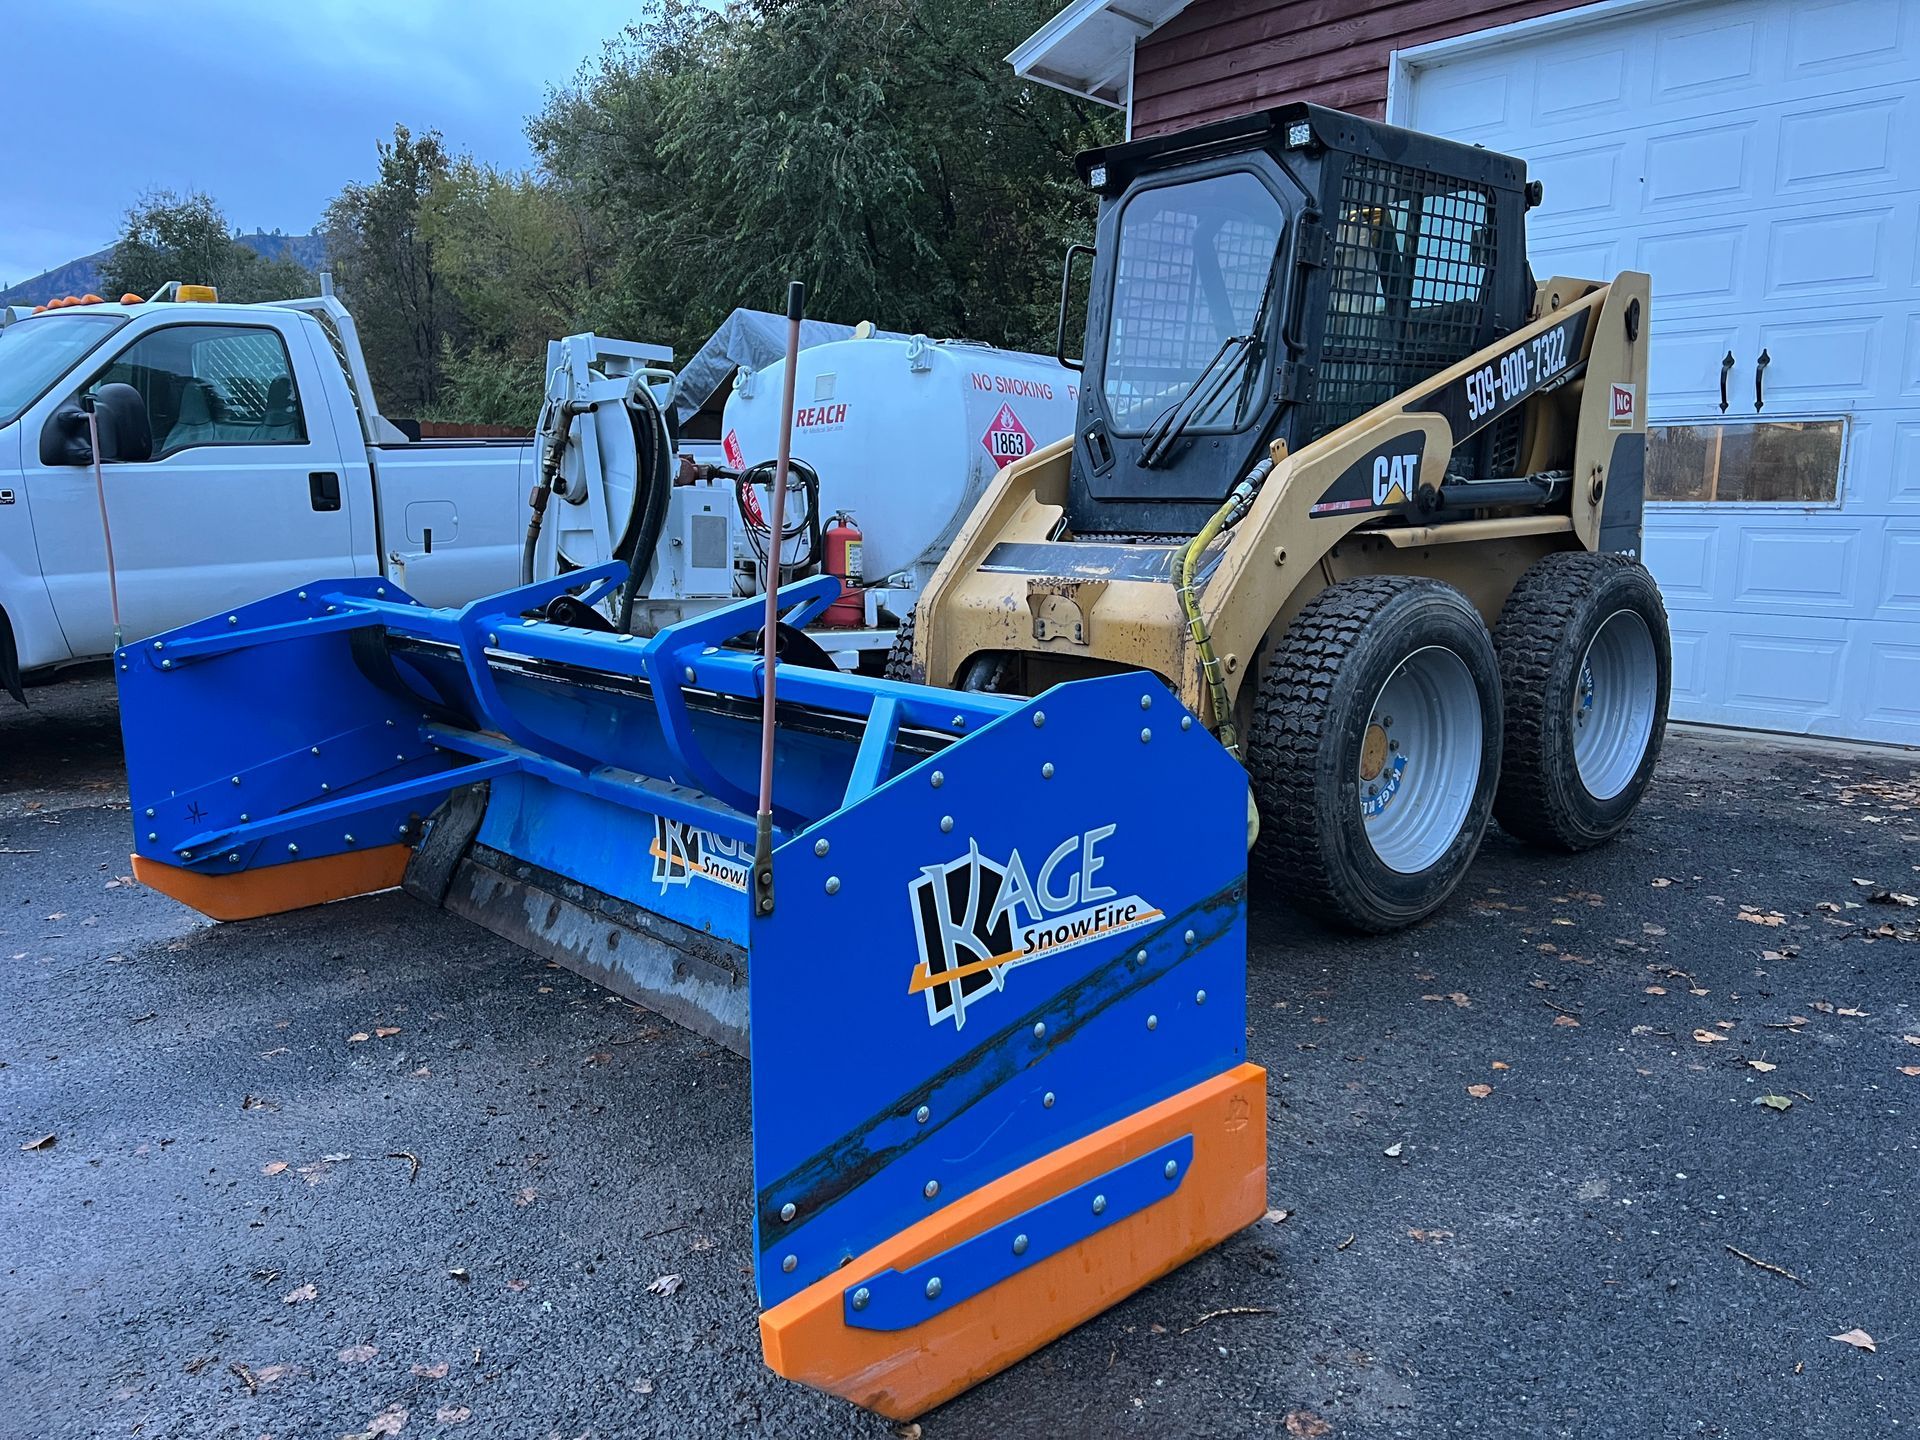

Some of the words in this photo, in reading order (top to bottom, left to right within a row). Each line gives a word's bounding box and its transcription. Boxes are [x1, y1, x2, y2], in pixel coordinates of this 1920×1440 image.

[971, 373, 992, 391] NO
[995, 376, 1053, 400] SMOKING
[1466, 326, 1566, 420] 509-800-7322
[796, 404, 847, 427] REACH
[1616, 394, 1630, 411] NC
[994, 432, 1024, 455] 1863
[1373, 455, 1418, 506] CAT
[1377, 768, 1401, 808] KAGE
[919, 823, 1118, 1031] KAGE
[1022, 903, 1138, 956] SnowFire
